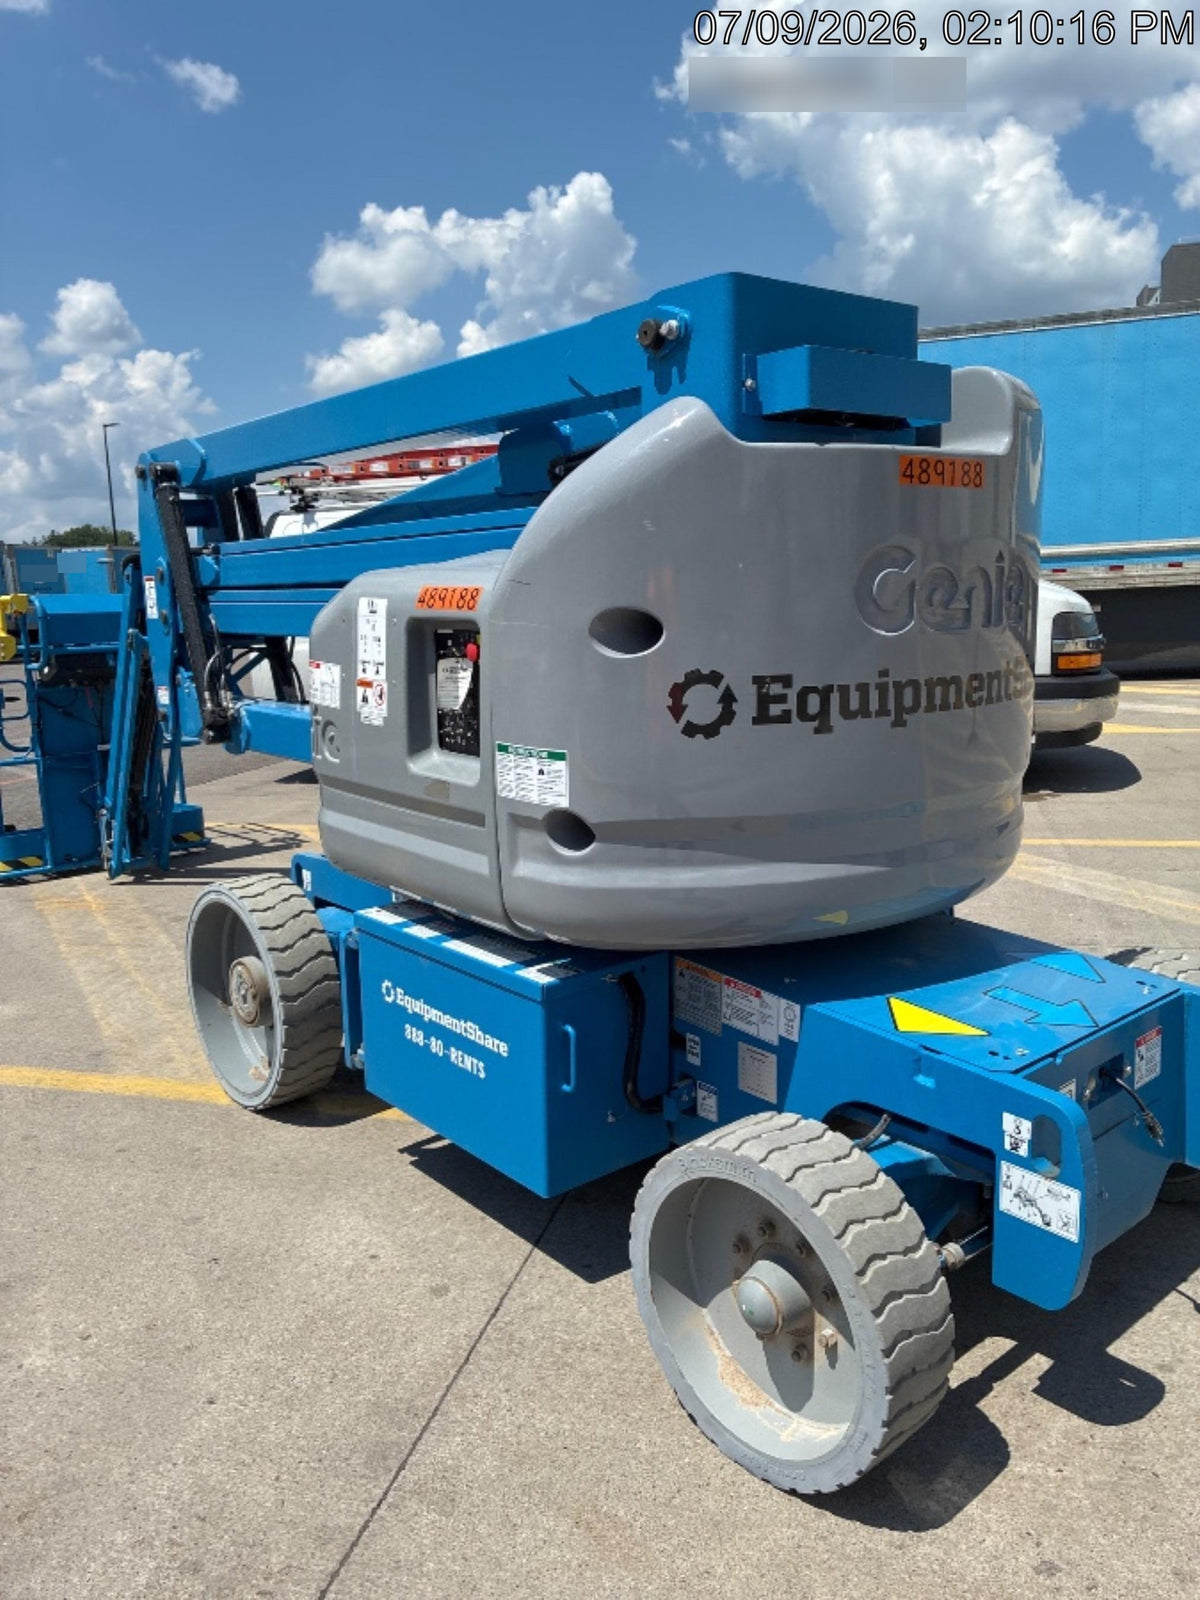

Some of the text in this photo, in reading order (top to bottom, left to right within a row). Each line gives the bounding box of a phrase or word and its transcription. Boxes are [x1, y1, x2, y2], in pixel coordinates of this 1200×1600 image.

[902, 458, 983, 488] 489188
[416, 587, 480, 611] 489188
[395, 986, 510, 1058] EquipmentShare
[404, 1023, 487, 1080] 888-80-RENTS
